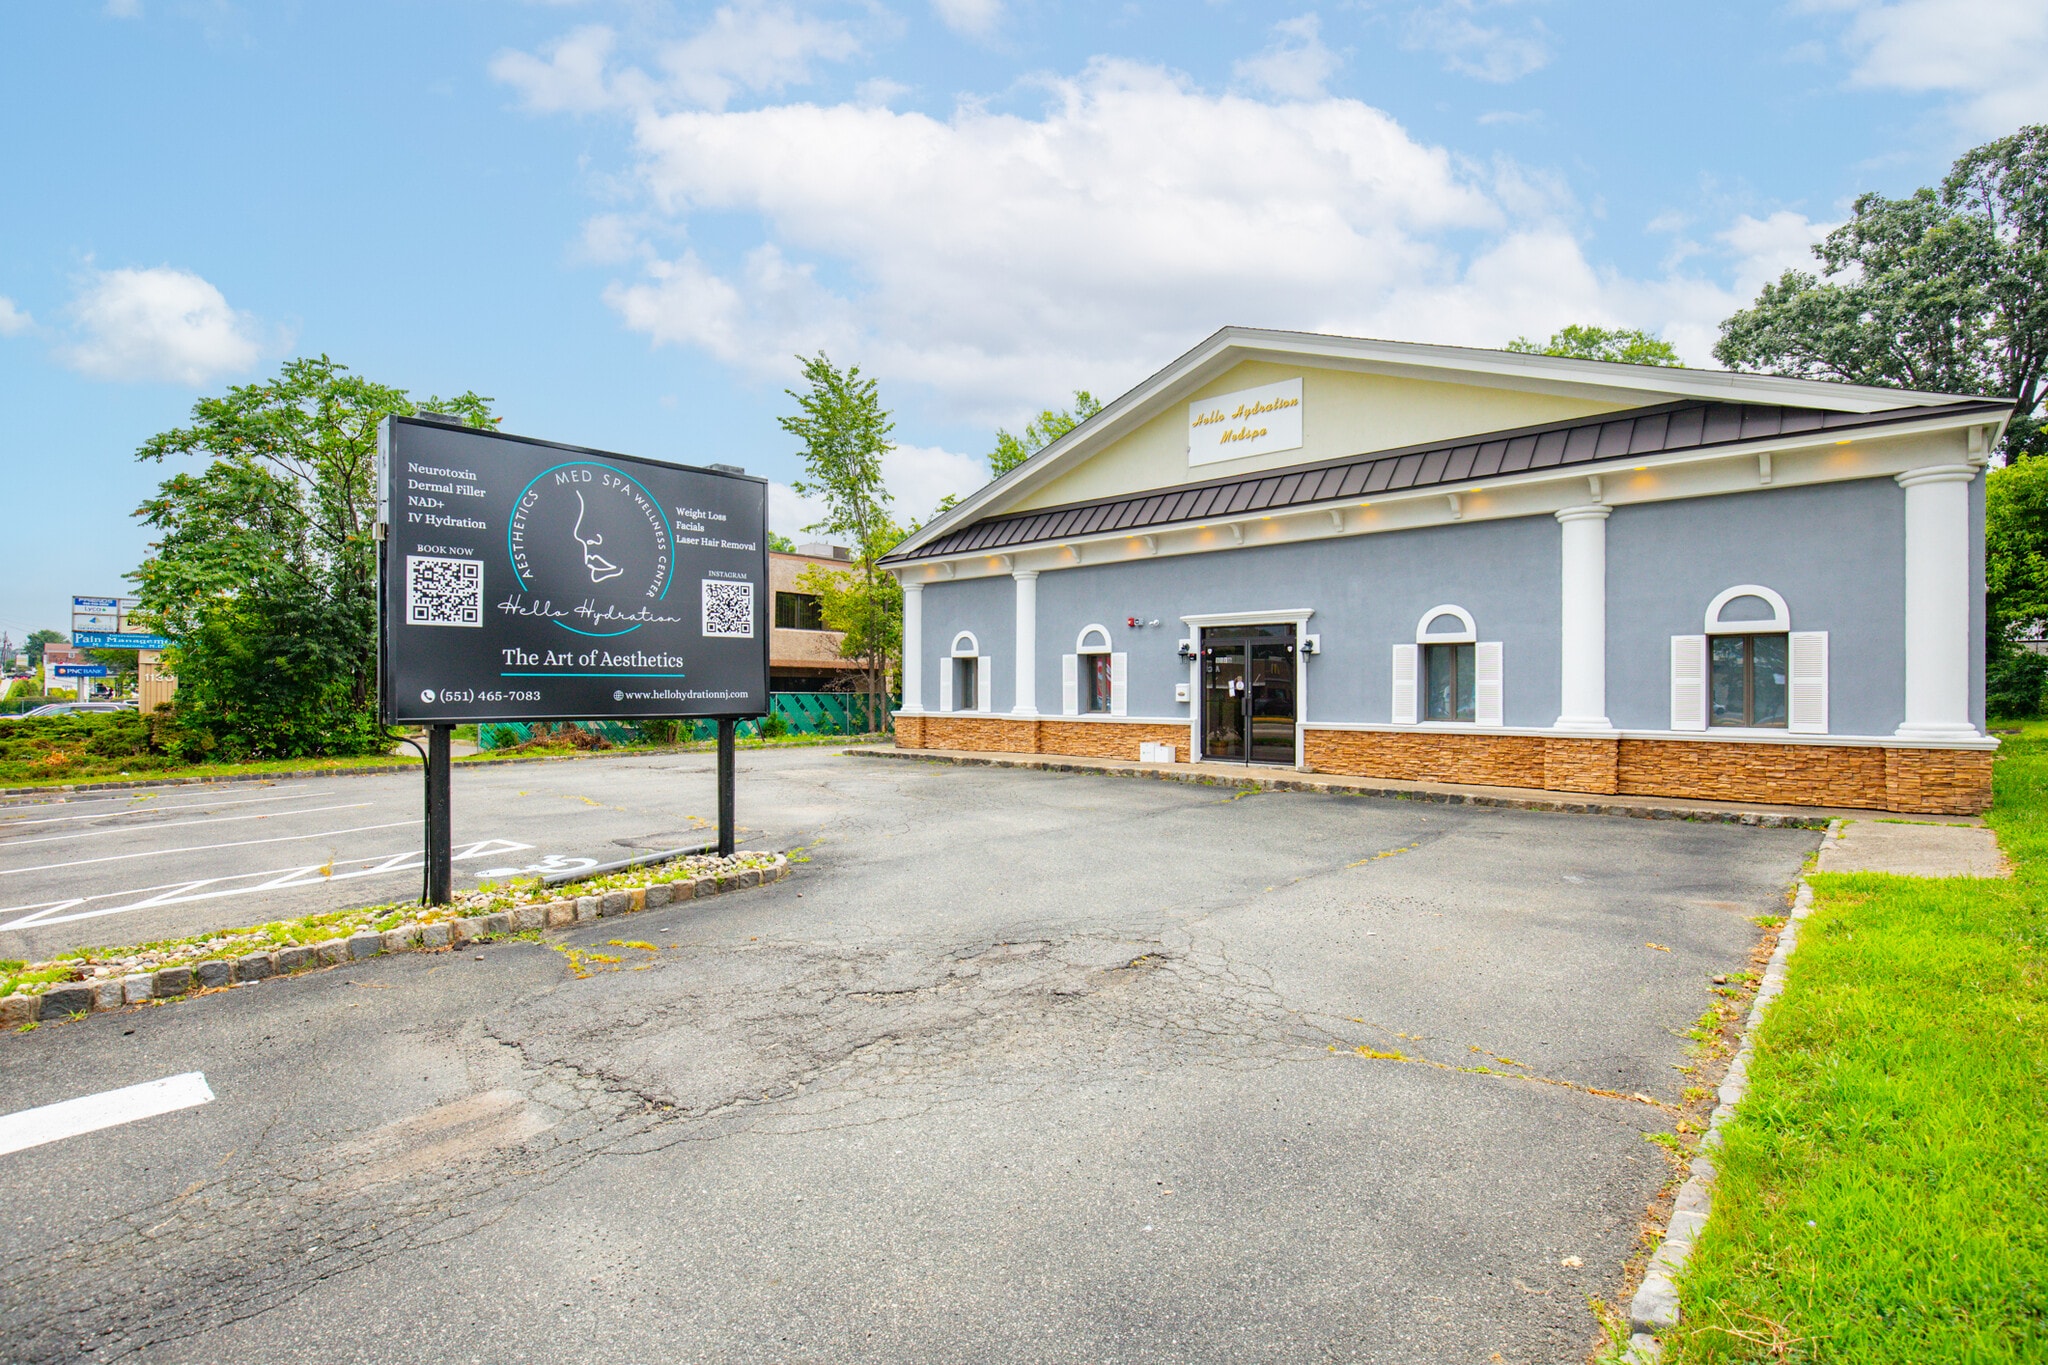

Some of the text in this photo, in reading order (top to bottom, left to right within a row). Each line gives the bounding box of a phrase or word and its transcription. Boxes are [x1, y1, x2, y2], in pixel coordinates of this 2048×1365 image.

[1192, 397, 1298, 428] Hello Hydration
[1220, 426, 1267, 445] Medspa
[408, 462, 477, 481] Neurotoxin
[408, 479, 487, 498] Dermal Filler
[555, 470, 630, 496] MED SPA
[408, 496, 445, 509] NAD+
[408, 512, 487, 530] IV Hydration
[676, 507, 727, 521] Weight Loss
[512, 489, 539, 579] AESTHETICS
[676, 521, 705, 532] Facials
[417, 544, 474, 556] BOOK NOW
[634, 493, 667, 598] WELLNESS CENTER
[676, 535, 756, 551] Laser Hair Removal
[708, 570, 747, 579] INSTAGRAM
[497, 594, 681, 626] Hello Hydration
[75, 633, 101, 643] Pain
[502, 648, 684, 668] The Art of Aesthetics
[440, 688, 541, 704] (551) 465-7083
[625, 689, 749, 701] www.hellohydrationnj.com
